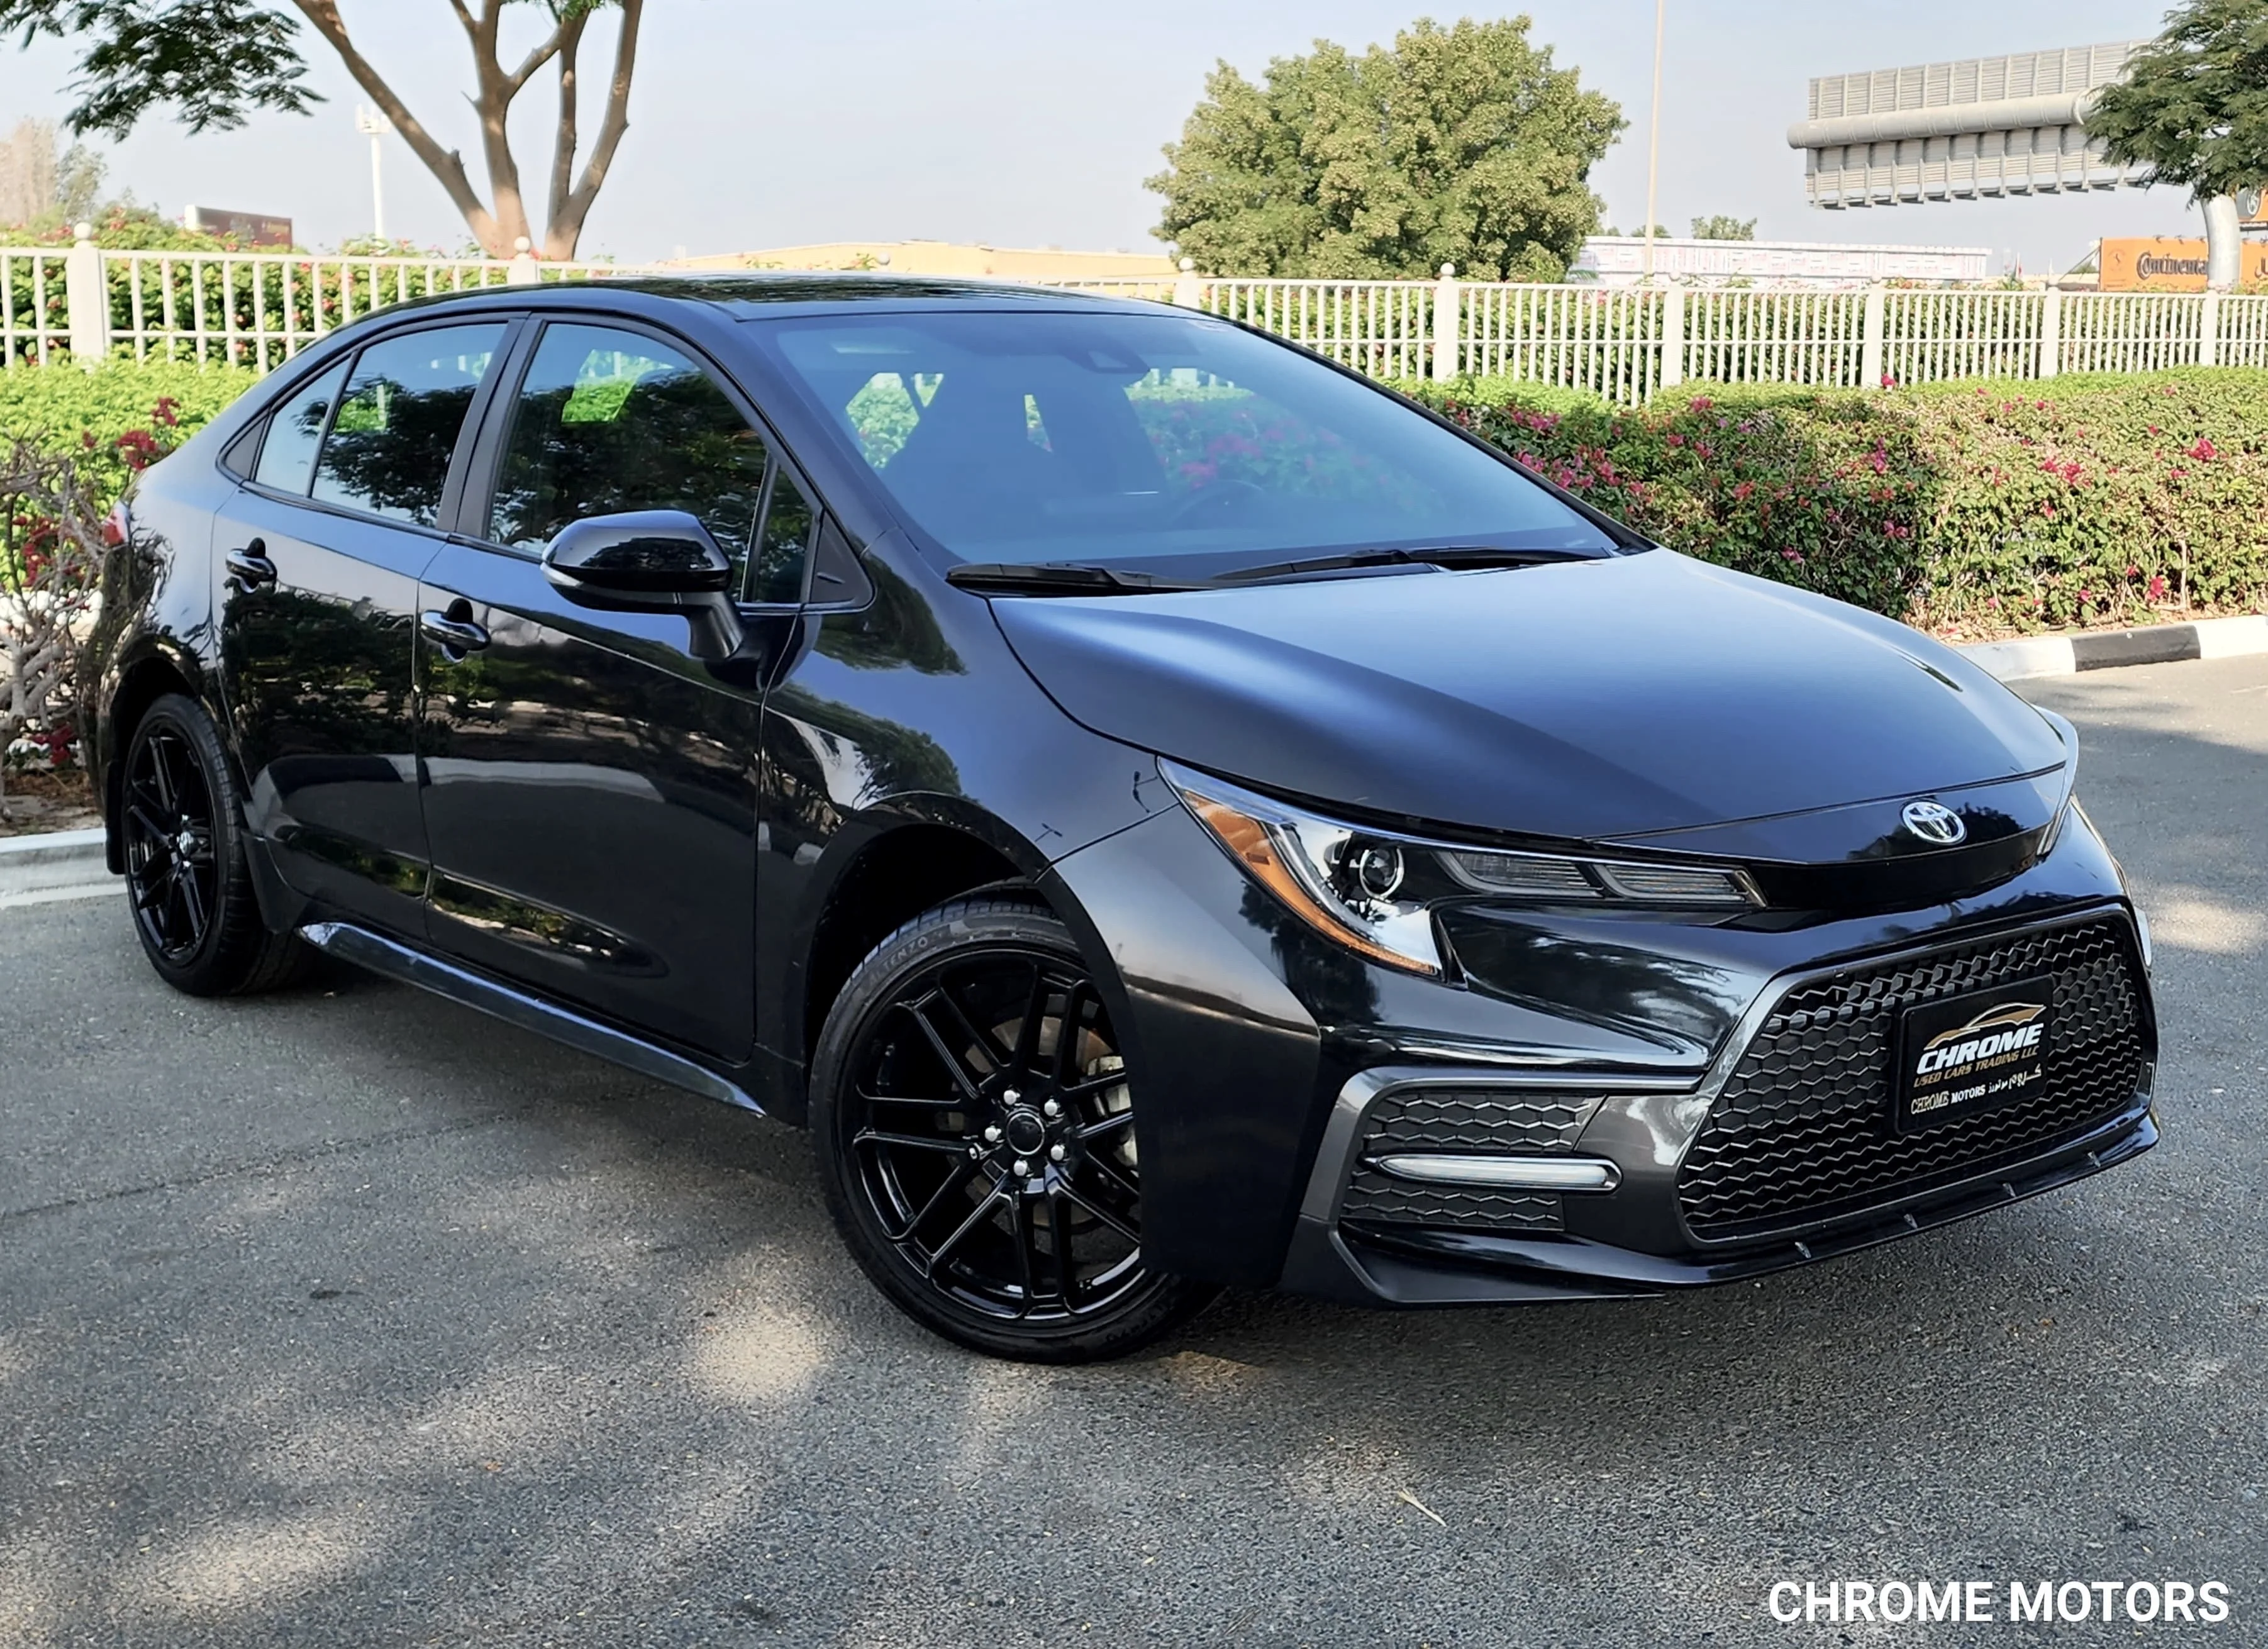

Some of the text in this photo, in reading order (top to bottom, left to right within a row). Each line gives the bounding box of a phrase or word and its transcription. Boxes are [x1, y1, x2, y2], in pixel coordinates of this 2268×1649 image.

[2137, 251, 2208, 280] Continenta
[869, 936, 928, 987] ALTENZO
[1913, 1045, 2040, 1088] USED CARS TRADING LLC
[1916, 1023, 2044, 1075] CHROME
[1911, 1084, 1986, 1115] CHROME MOTORS
